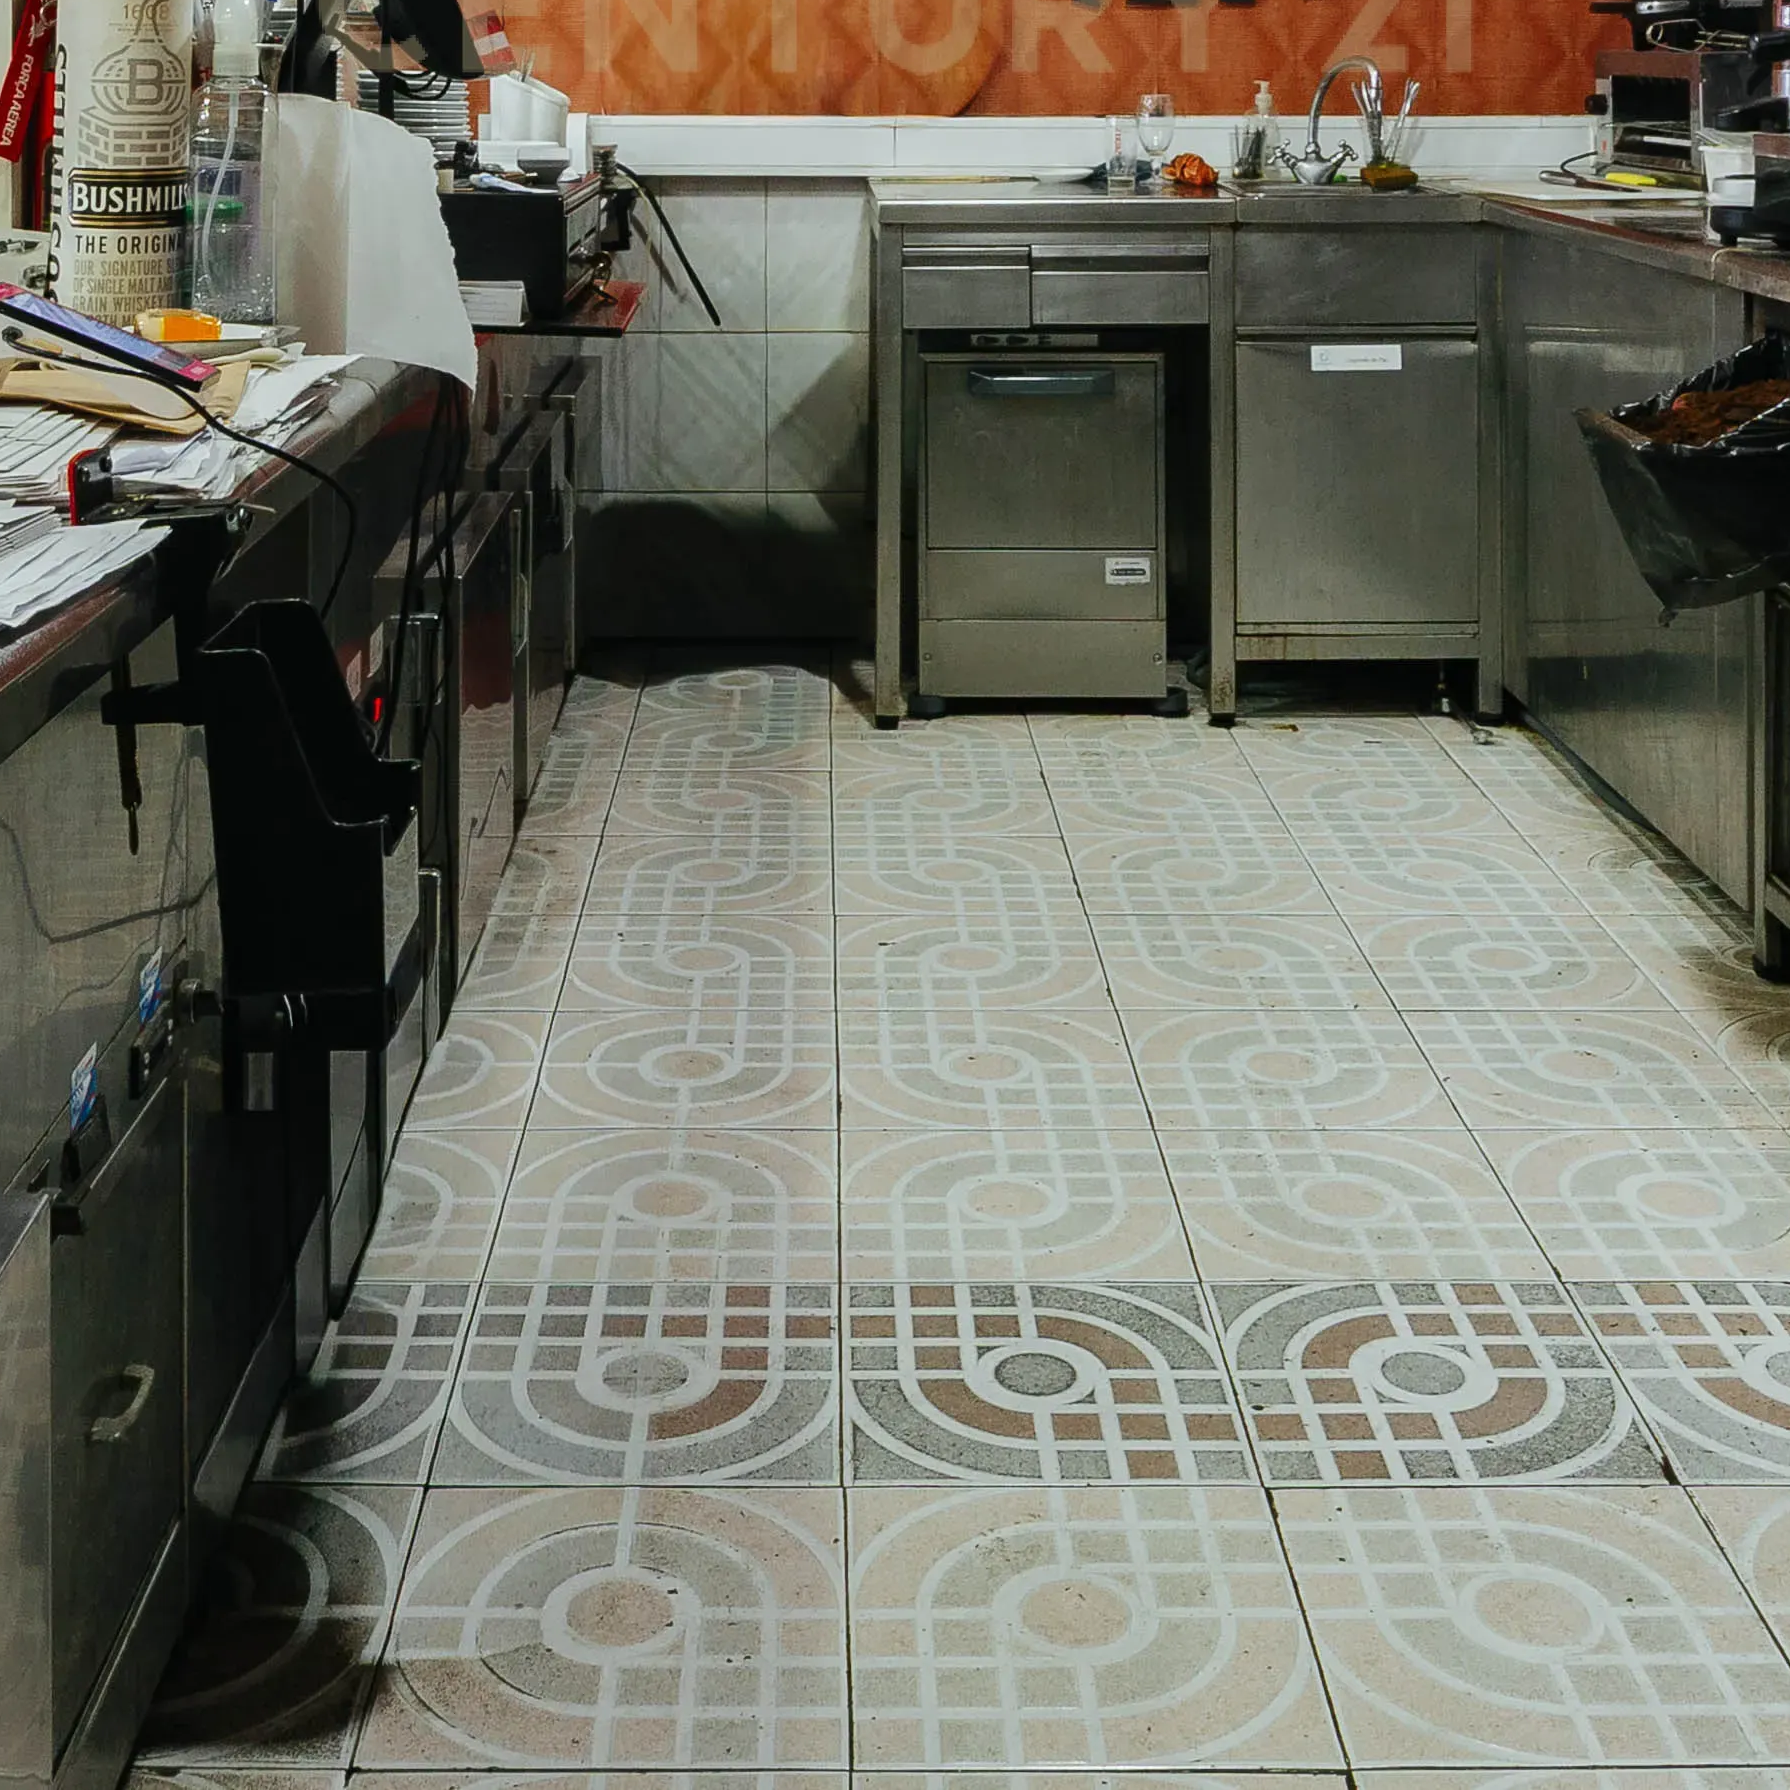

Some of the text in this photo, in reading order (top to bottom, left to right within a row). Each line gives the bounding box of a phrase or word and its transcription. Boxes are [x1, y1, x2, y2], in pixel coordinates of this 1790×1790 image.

[11, 53, 35, 102] FORÇA
[126, 57, 164, 106] B
[74, 234, 108, 254] THE
